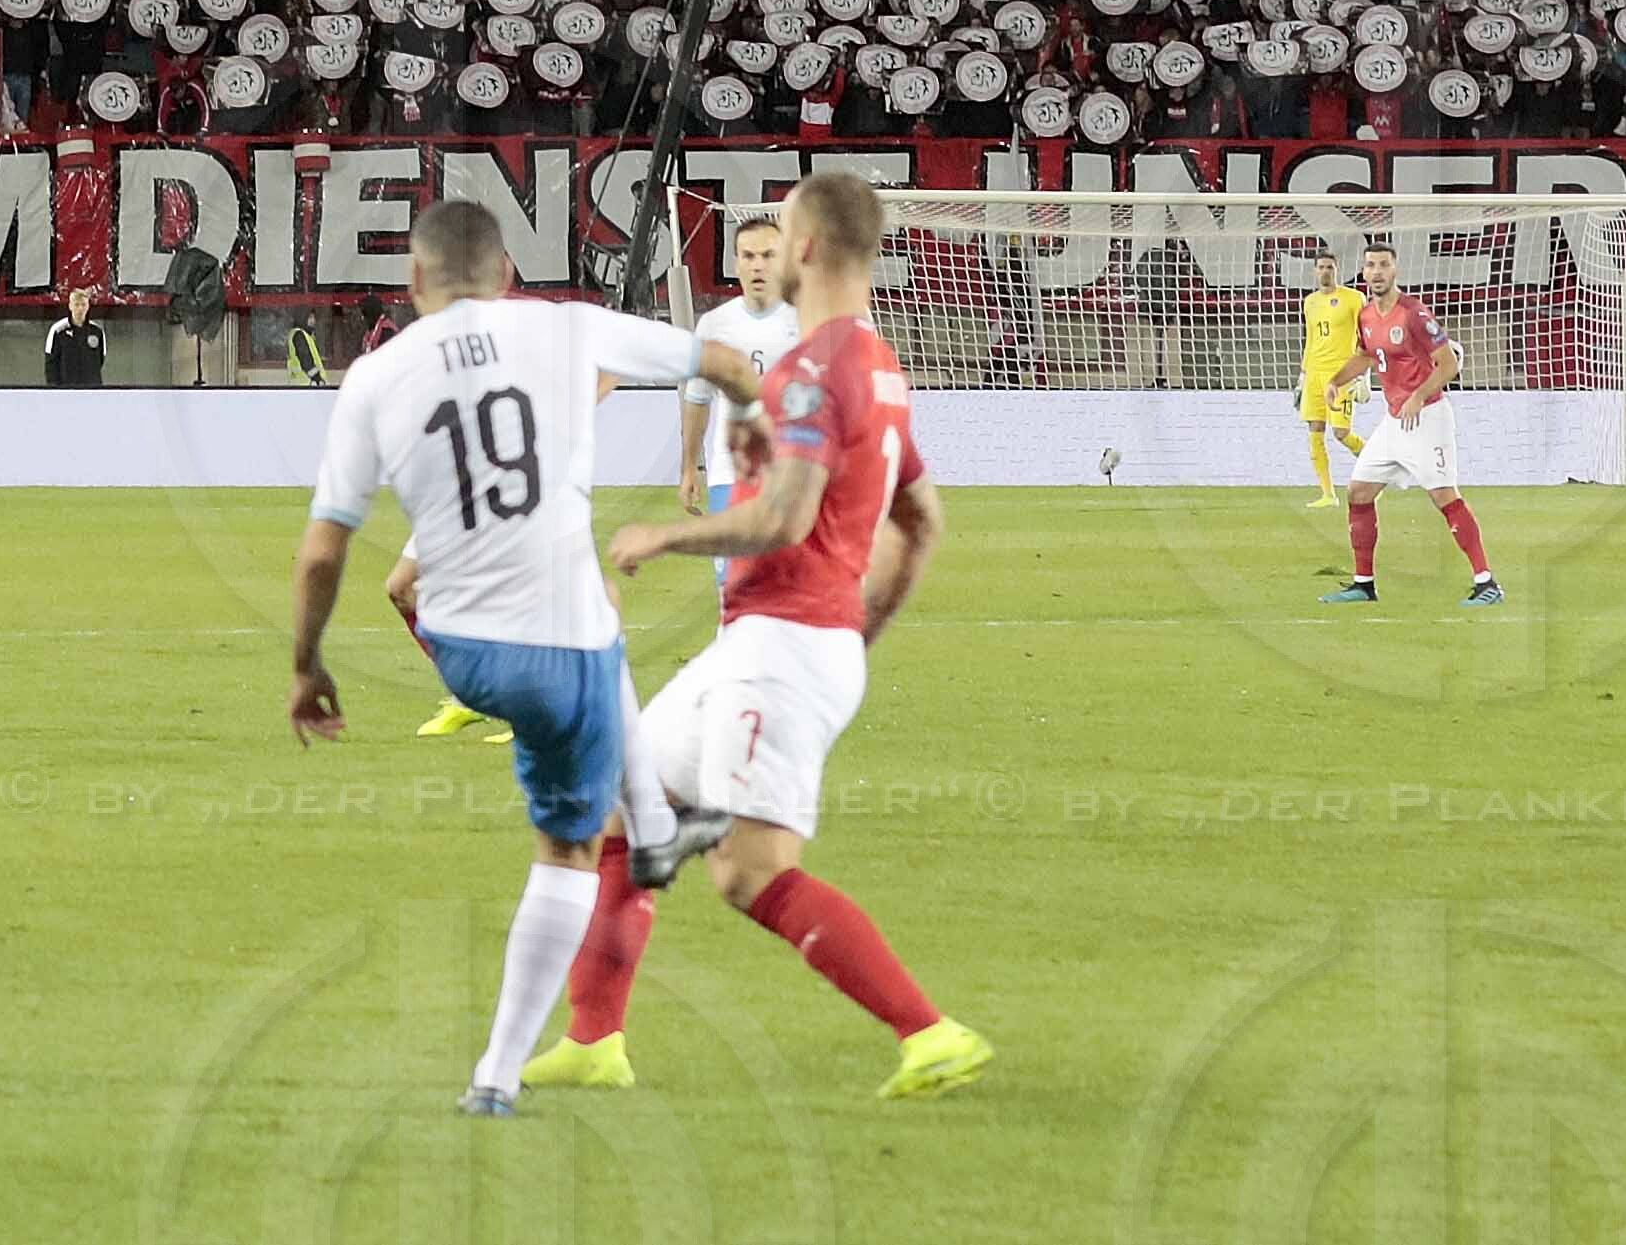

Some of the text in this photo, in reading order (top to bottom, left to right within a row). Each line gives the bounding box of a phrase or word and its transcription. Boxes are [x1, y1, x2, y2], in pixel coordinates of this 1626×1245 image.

[1317, 321, 1330, 337] 13
[437, 332, 500, 372] TIBI
[1375, 348, 1387, 373] 3
[1341, 398, 1353, 416] 13
[425, 386, 541, 530] 19
[1433, 446, 1447, 468] 3
[739, 709, 764, 765] 7
